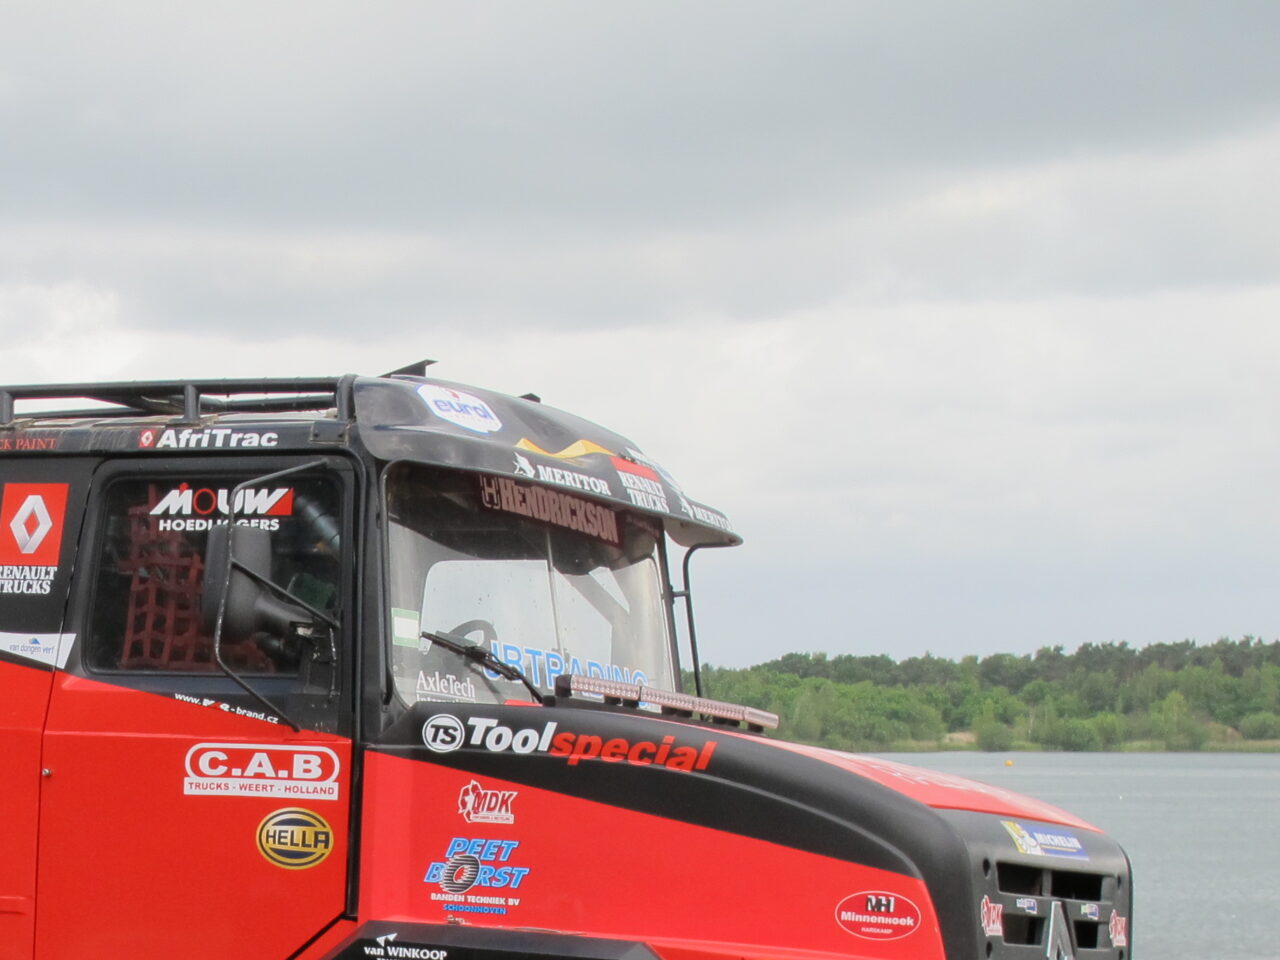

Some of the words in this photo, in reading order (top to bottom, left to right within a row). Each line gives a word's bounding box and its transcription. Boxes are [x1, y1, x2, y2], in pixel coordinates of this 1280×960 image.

[16, 438, 57, 450] PAINT
[156, 429, 279, 448] AfriTrac
[537, 464, 612, 496] MERITOR
[498, 477, 619, 544] HENDRICKSON
[416, 671, 476, 699] AxleTech
[429, 724, 460, 744] TS
[198, 750, 323, 779] C.A.B
[188, 782, 230, 791] TRUCKS
[239, 784, 274, 793] WEERT
[284, 786, 335, 795] HOLLAND
[266, 829, 331, 850] HELLA
[445, 837, 519, 862] PEET
[1034, 832, 1083, 849] MICHELIN
[431, 893, 464, 902] BANDEN
[467, 896, 505, 905] TECHNIEK
[364, 946, 384, 956] van
[387, 947, 447, 960] WINKOOP
